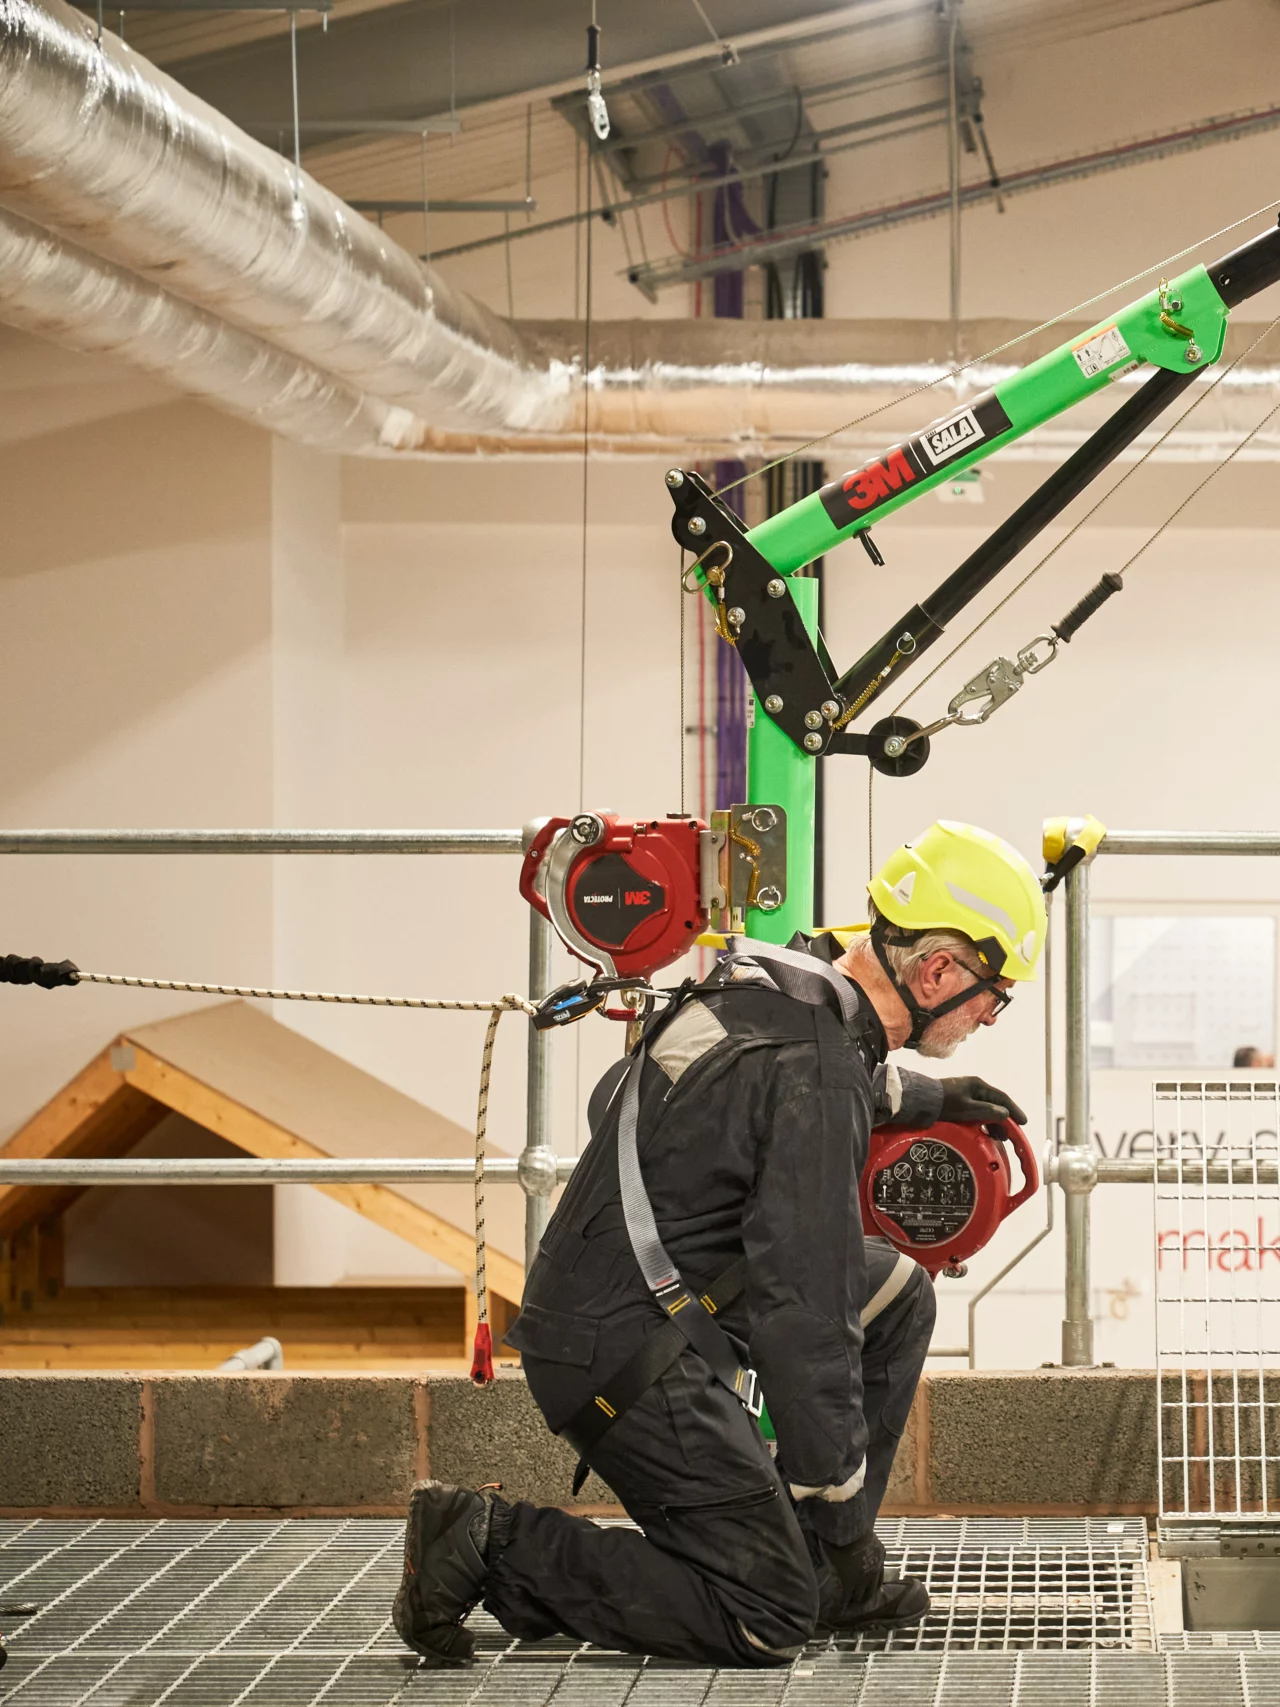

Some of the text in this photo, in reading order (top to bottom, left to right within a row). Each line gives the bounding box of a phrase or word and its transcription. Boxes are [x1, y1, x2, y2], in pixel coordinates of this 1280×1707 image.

[930, 418, 975, 454] SALA
[843, 448, 916, 510] 3M
[583, 891, 651, 905] 3M PROTECTA
